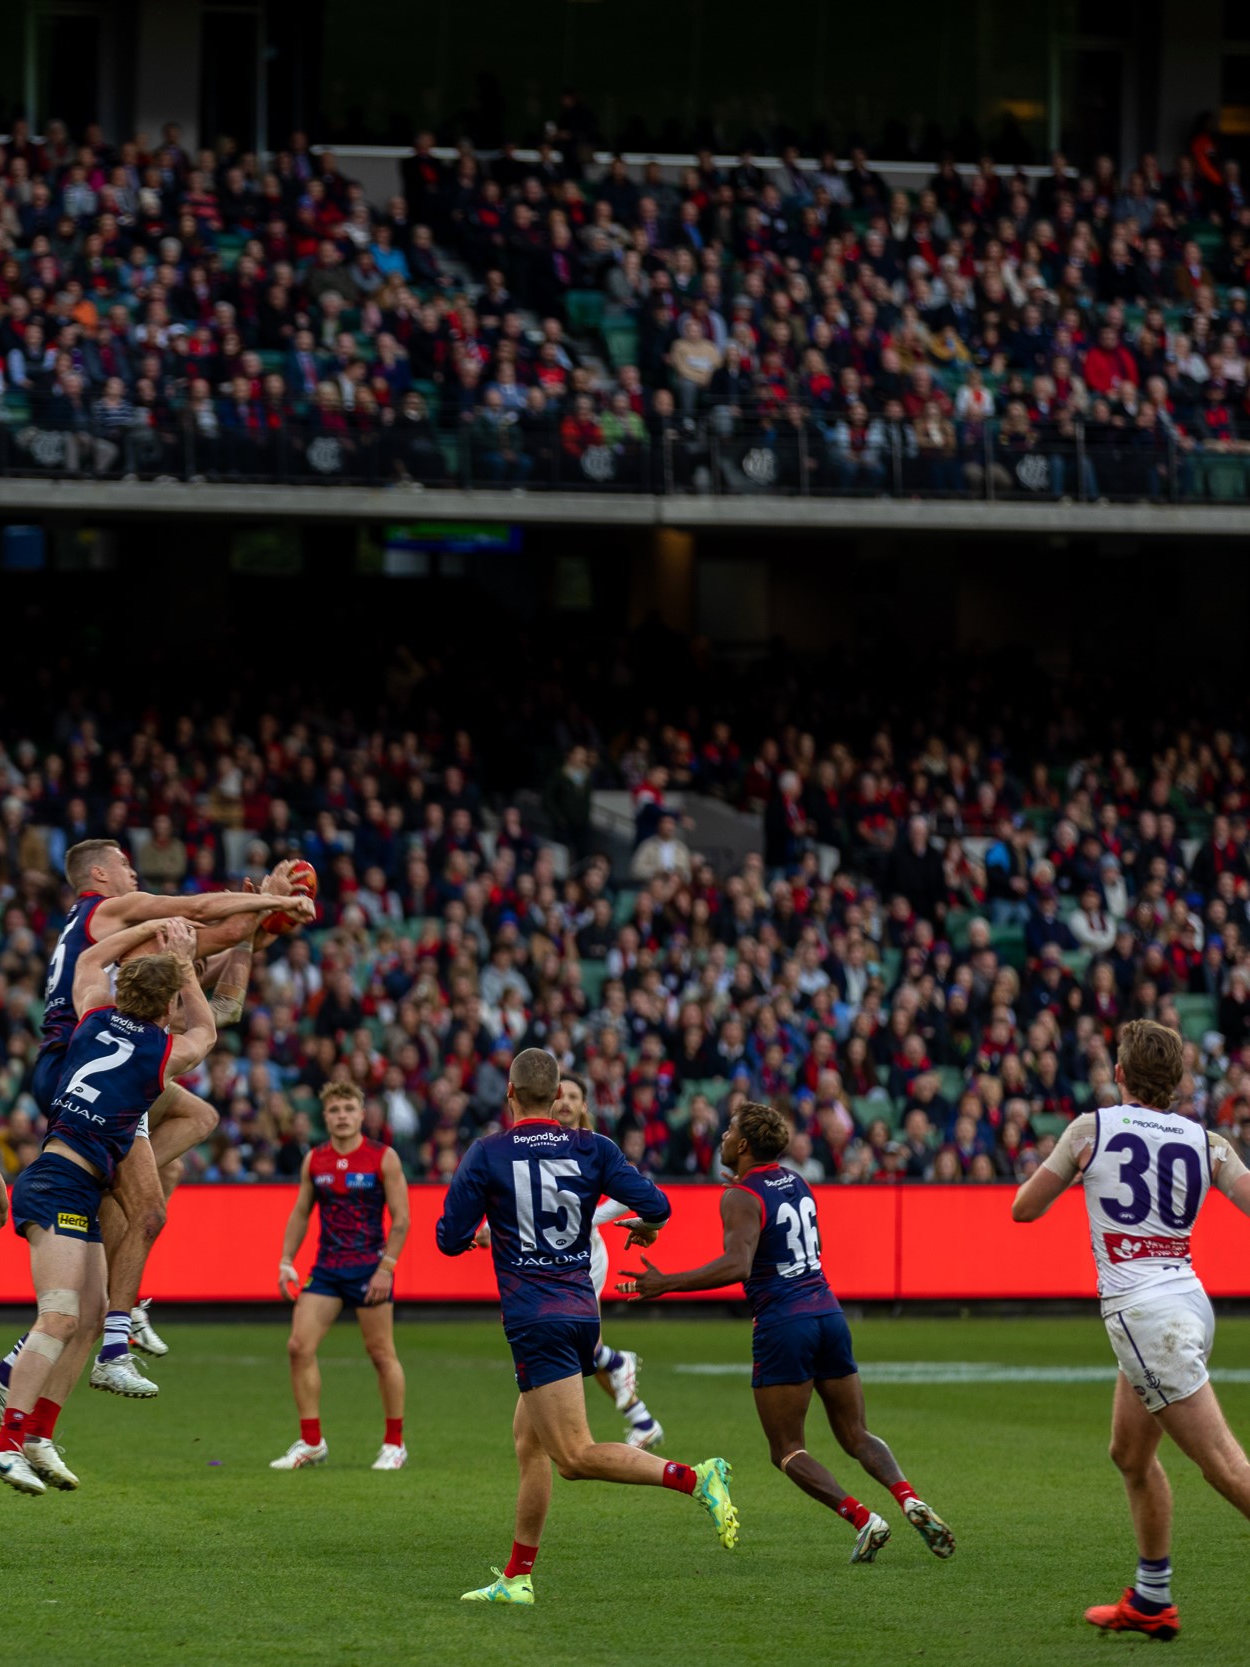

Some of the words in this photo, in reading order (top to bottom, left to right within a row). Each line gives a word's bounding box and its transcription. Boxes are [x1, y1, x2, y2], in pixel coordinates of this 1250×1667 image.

[66, 1030, 136, 1103] 2
[51, 1098, 107, 1126] JAGUAR
[513, 1132, 548, 1144] Beyond
[548, 1132, 570, 1142] Bank
[512, 1159, 582, 1252] 15
[1099, 1132, 1200, 1229] 30
[60, 1214, 89, 1228] Hertz
[776, 1196, 822, 1278] 36
[510, 1250, 590, 1266] JAGUAR
